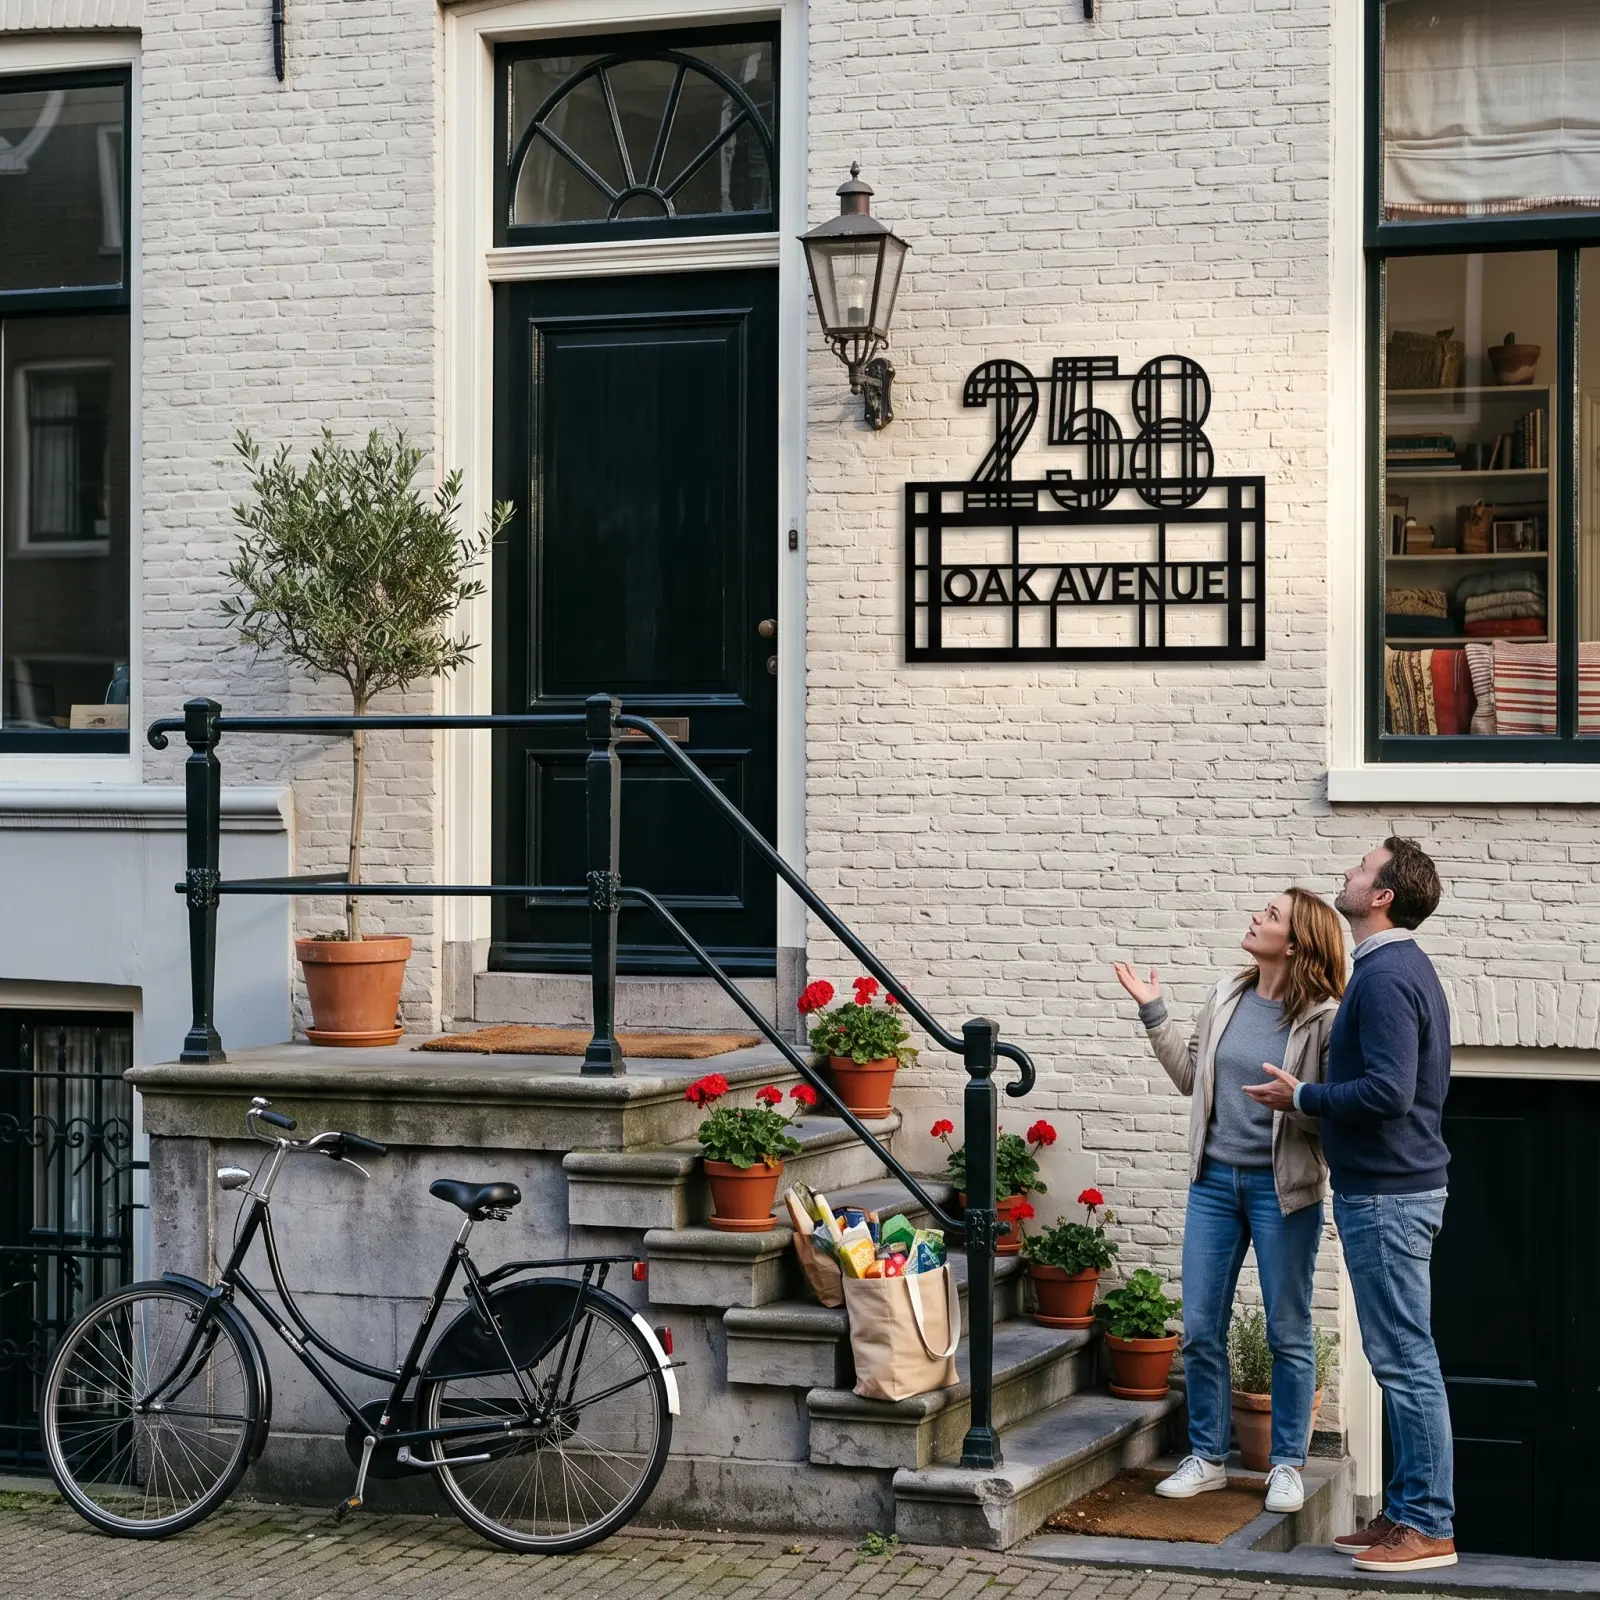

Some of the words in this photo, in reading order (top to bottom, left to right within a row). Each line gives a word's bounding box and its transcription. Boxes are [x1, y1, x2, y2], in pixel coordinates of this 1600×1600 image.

[963, 354, 1214, 512] 258
[943, 567, 1040, 602] OAK
[1050, 566, 1225, 601] AVENUE
